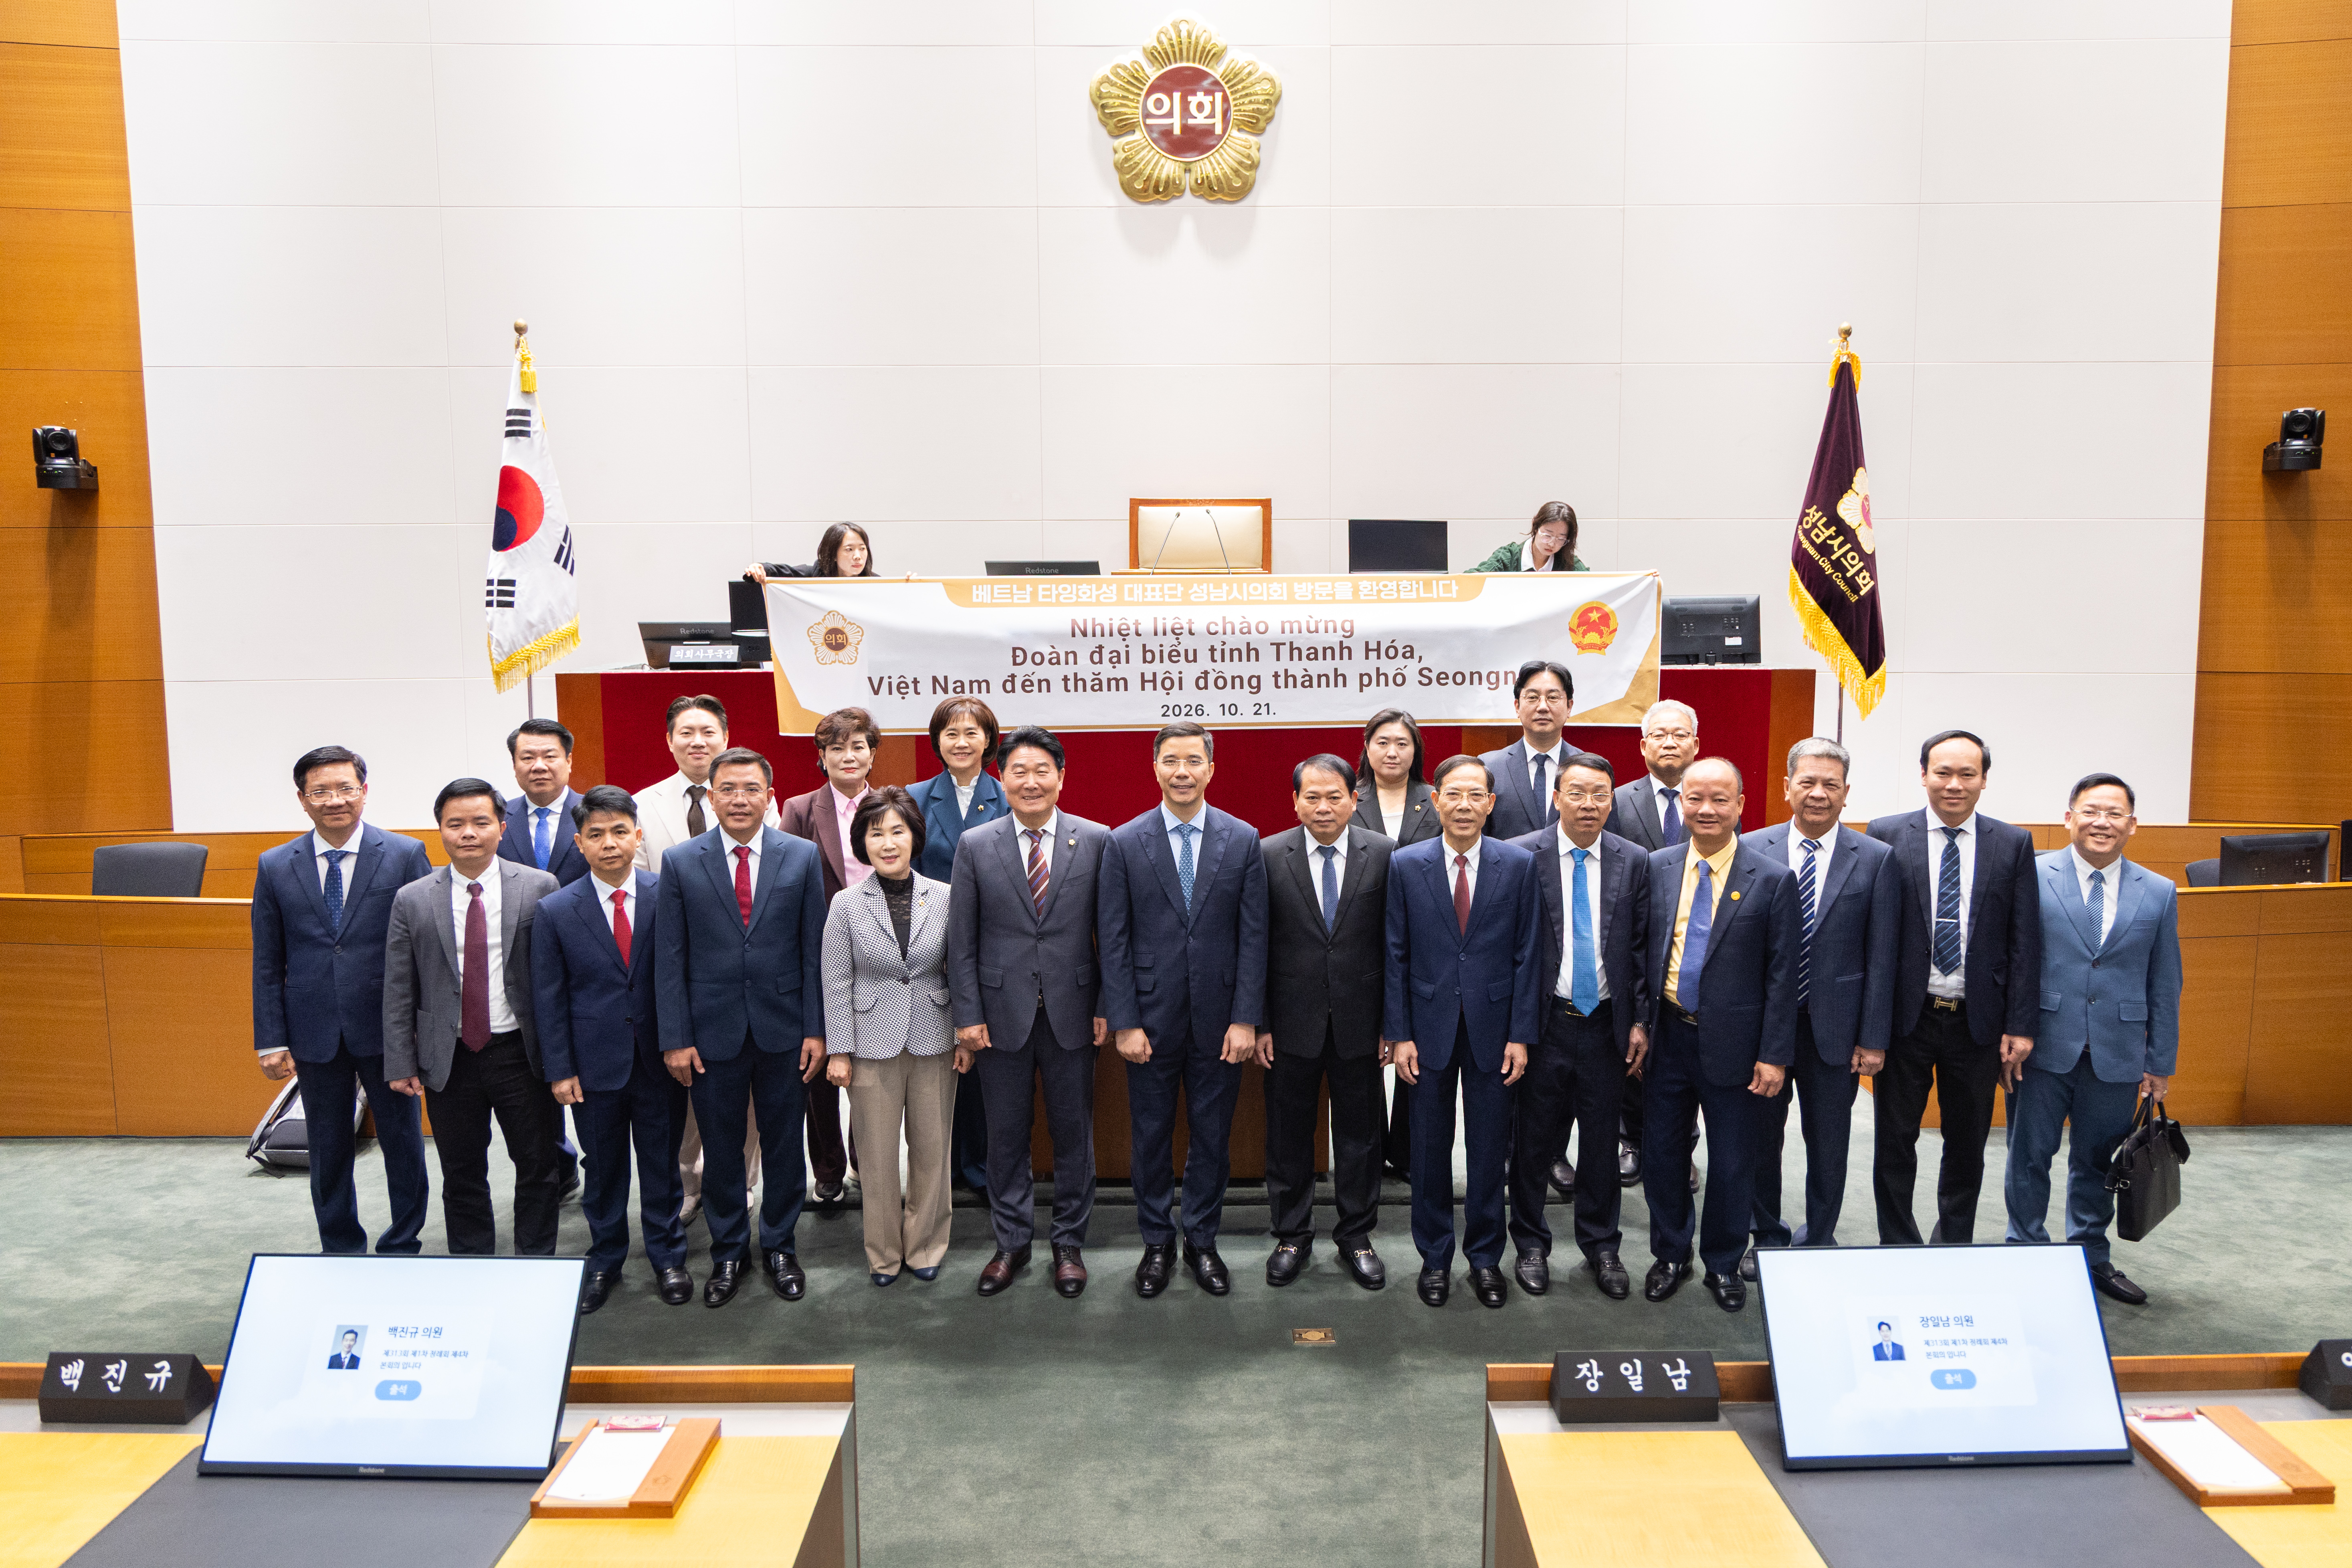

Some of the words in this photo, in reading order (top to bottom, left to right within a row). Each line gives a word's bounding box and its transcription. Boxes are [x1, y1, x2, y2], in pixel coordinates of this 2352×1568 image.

[1146, 92, 1223, 135] 의회
[1802, 505, 1875, 596] 성남시의회
[1819, 557, 1835, 574] City
[1832, 572, 1859, 602] Council
[972, 584, 1033, 603] 베트남
[1038, 584, 1117, 603] 타잉화성
[1124, 583, 1184, 602] 대표단
[1188, 582, 1287, 602] 성남시의회
[1294, 581, 1354, 600] 방문을
[1358, 580, 1459, 600] 환영합니다
[1071, 617, 1142, 642] Nhiệt
[1153, 616, 1196, 641] liệt
[1206, 616, 1269, 636] chào
[1281, 615, 1355, 639] mừng
[825, 634, 847, 645] 의회
[674, 649, 734, 660] 의회사무국장
[1011, 645, 1078, 667] Đoàn
[1089, 644, 1130, 669] đại
[1142, 641, 1198, 664] biểu
[1208, 641, 1260, 663] tỉnh
[1270, 640, 1353, 662] Thanh
[1365, 639, 1423, 664] Hóa,
[867, 675, 921, 700] Việt
[932, 675, 990, 695] Nam
[1002, 671, 1051, 694] đến
[1061, 671, 1129, 693] thăm
[1140, 671, 1183, 696] Hội
[1195, 668, 1261, 695] đồng
[1272, 667, 1347, 689] thành
[1359, 665, 1408, 693] phố
[1417, 667, 1517, 691] Seongn
[1161, 704, 1210, 717] 2026.
[1219, 703, 1243, 716] 10.
[1253, 703, 1276, 715] 21.
[1920, 1315, 1950, 1328] 장일남
[1953, 1315, 1974, 1327] 의원
[388, 1326, 419, 1338] 백진규
[421, 1326, 443, 1338] 의원
[1924, 1339, 1950, 1347] 제313회
[1970, 1338, 1990, 1346] 정례회
[1990, 1338, 2008, 1346] 제4차
[383, 1349, 409, 1357] 제313회
[410, 1350, 428, 1358] 제1차
[430, 1350, 450, 1358] 정례회
[451, 1350, 469, 1358] 제4차
[1926, 1351, 1946, 1359] 본회의
[402, 1362, 422, 1370] 입니다
[1575, 1358, 1691, 1392] 장일남
[60, 1359, 172, 1392] 백진규
